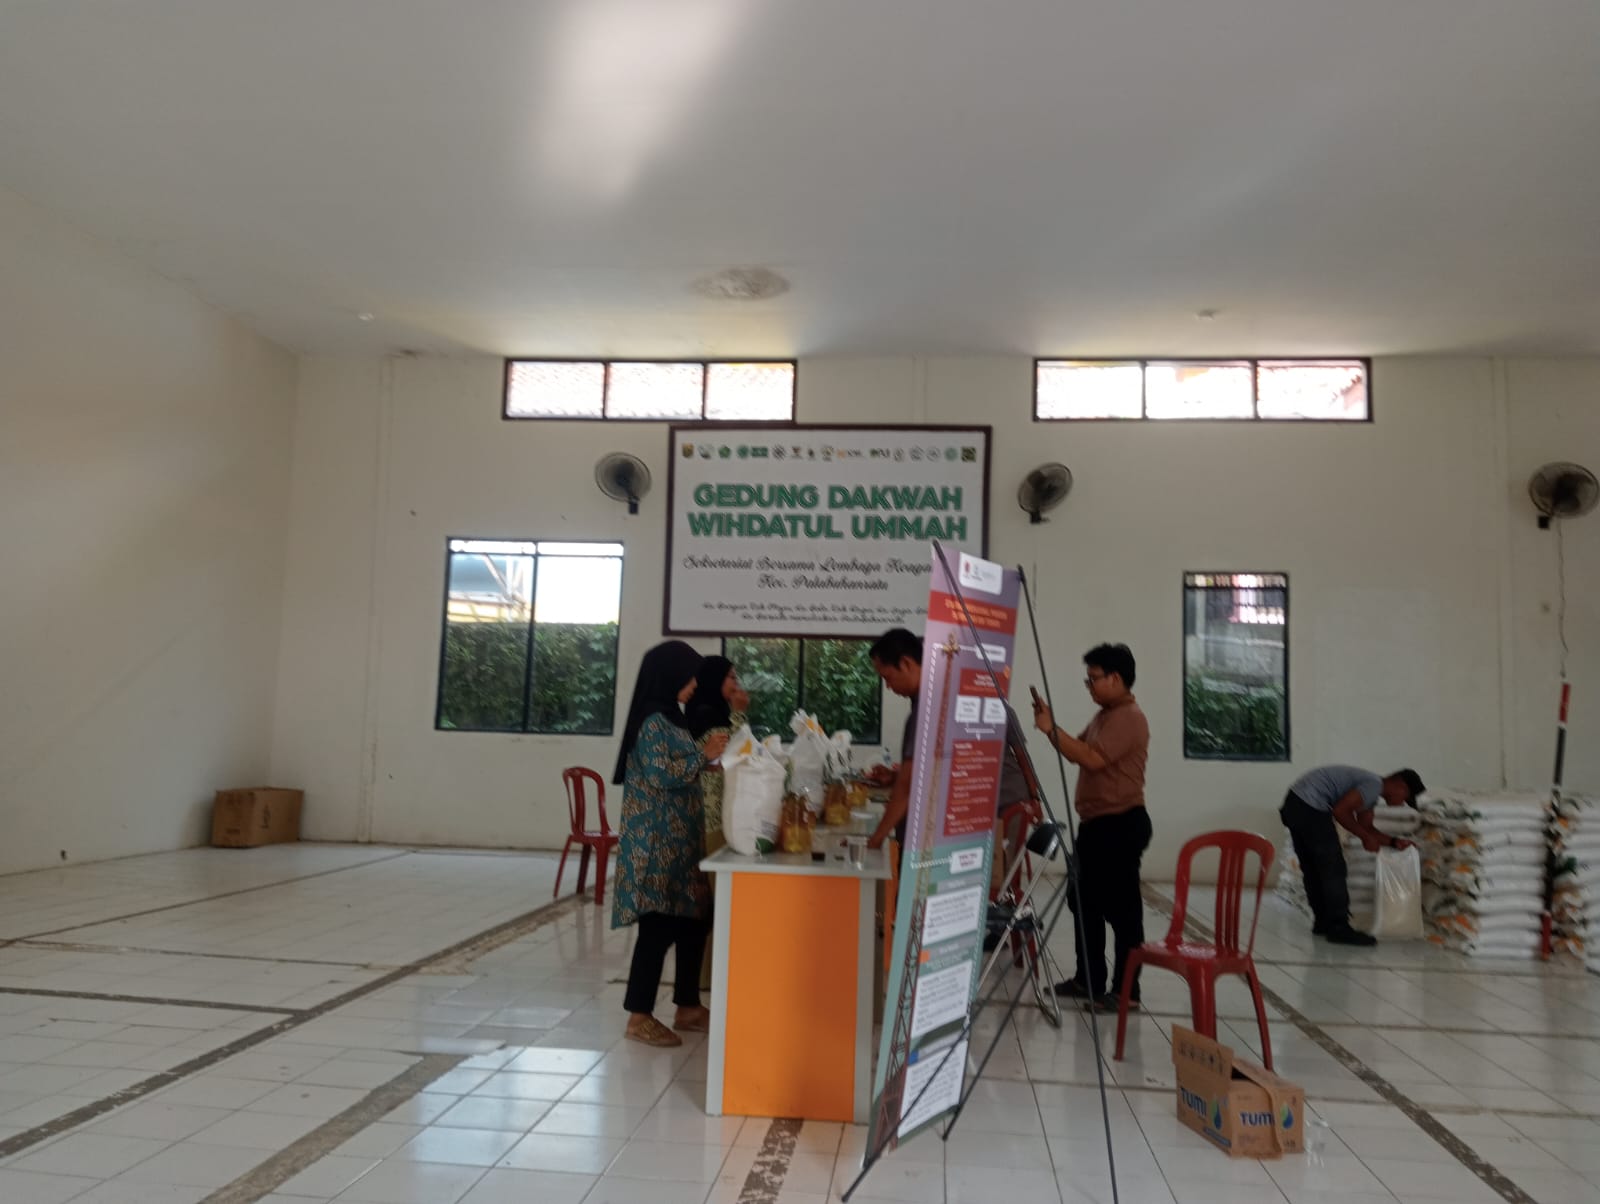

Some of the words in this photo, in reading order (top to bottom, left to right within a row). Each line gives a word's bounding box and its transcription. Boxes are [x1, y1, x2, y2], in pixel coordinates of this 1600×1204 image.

[694, 483, 819, 508] GEDUNG
[828, 485, 963, 510] DAKWAH
[687, 512, 843, 538] WIHDATUL
[851, 515, 967, 540] UMMAH
